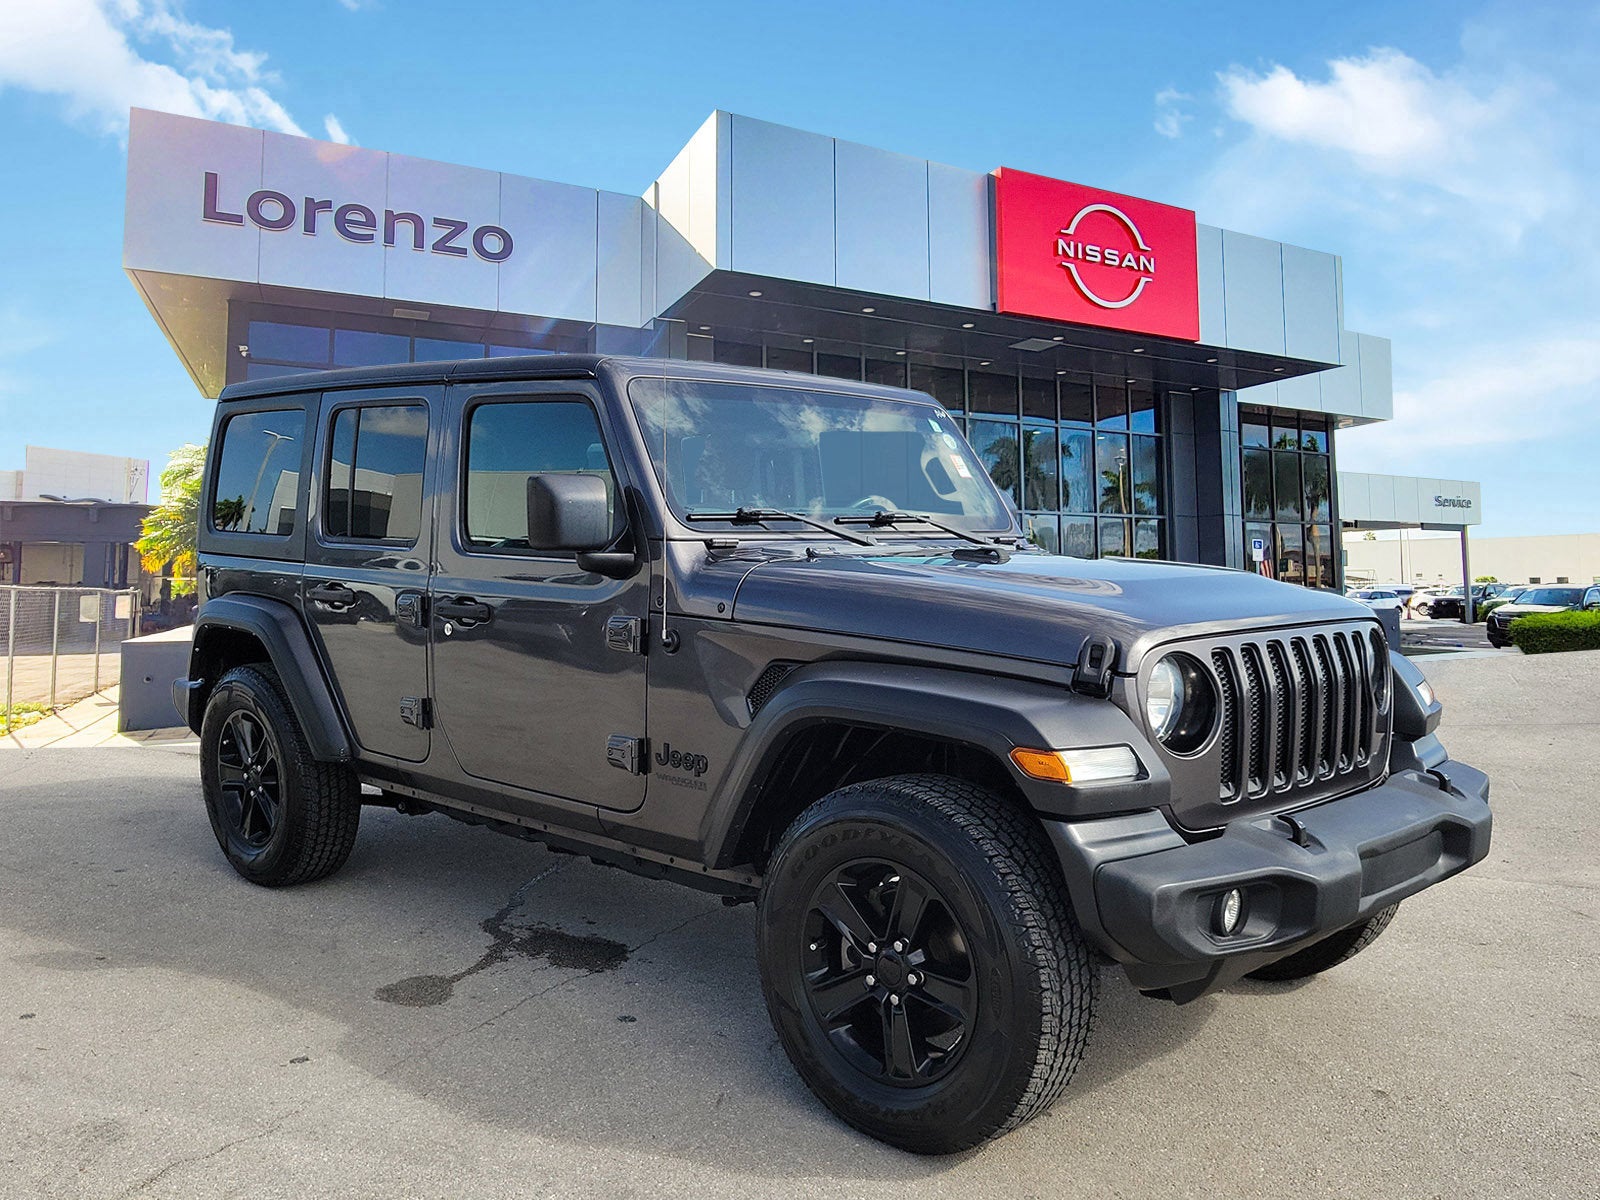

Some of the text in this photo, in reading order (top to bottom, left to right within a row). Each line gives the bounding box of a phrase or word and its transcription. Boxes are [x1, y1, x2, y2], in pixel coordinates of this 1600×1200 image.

[203, 171, 514, 262] Lorenzo
[1057, 238, 1155, 273] NISSAN
[1434, 495, 1472, 508] Service
[655, 742, 709, 777] Jeep
